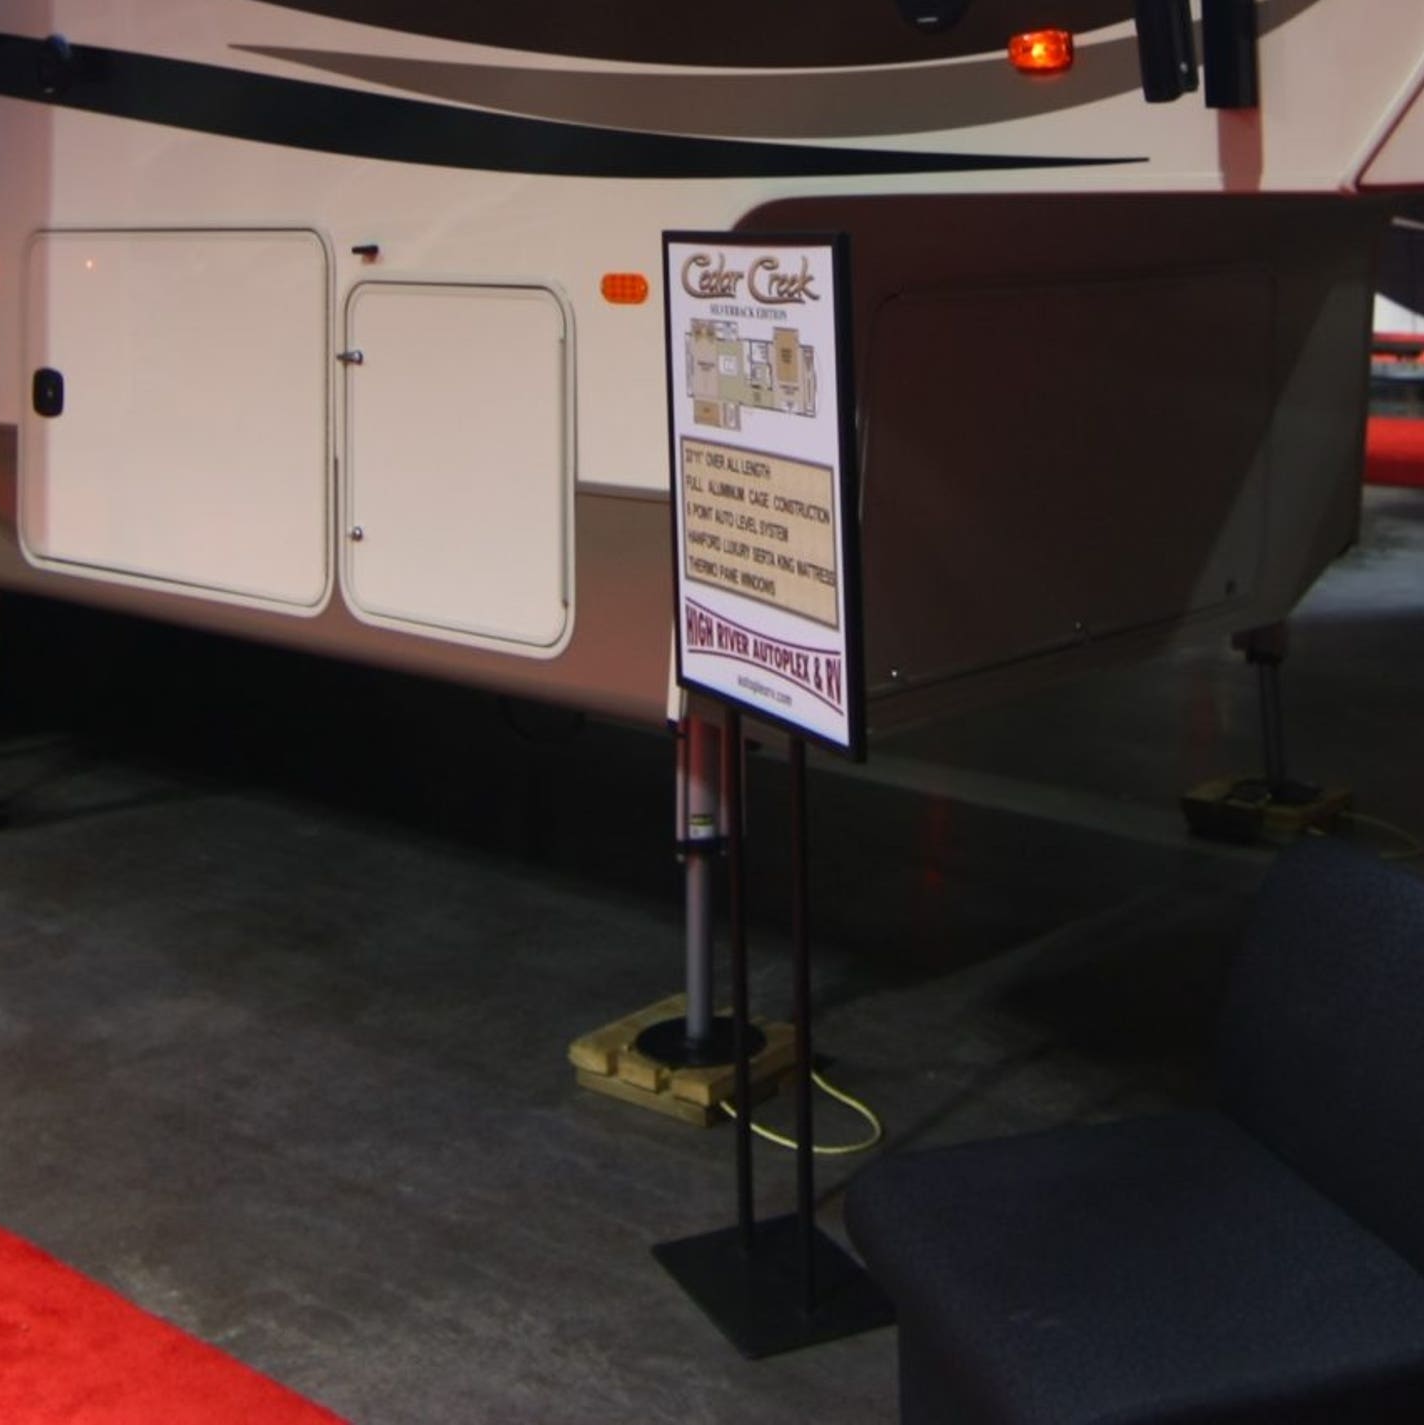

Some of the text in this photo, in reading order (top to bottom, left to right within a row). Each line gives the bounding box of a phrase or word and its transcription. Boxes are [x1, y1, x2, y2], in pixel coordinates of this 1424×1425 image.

[681, 252, 820, 305] Cedar Creek
[705, 451, 724, 469] OVER
[726, 457, 739, 473] ALL
[742, 460, 771, 478] LENGTH
[686, 474, 703, 492] FULL
[748, 489, 769, 508] CAGE
[773, 495, 830, 523] CONSTRUCTION
[693, 503, 713, 521] POINT
[715, 508, 734, 526] AUTO
[736, 513, 757, 534] LEVEL
[759, 520, 789, 542] SYSTEM
[685, 604, 841, 705] HIGH RIVER AUTOPLEX & RV
